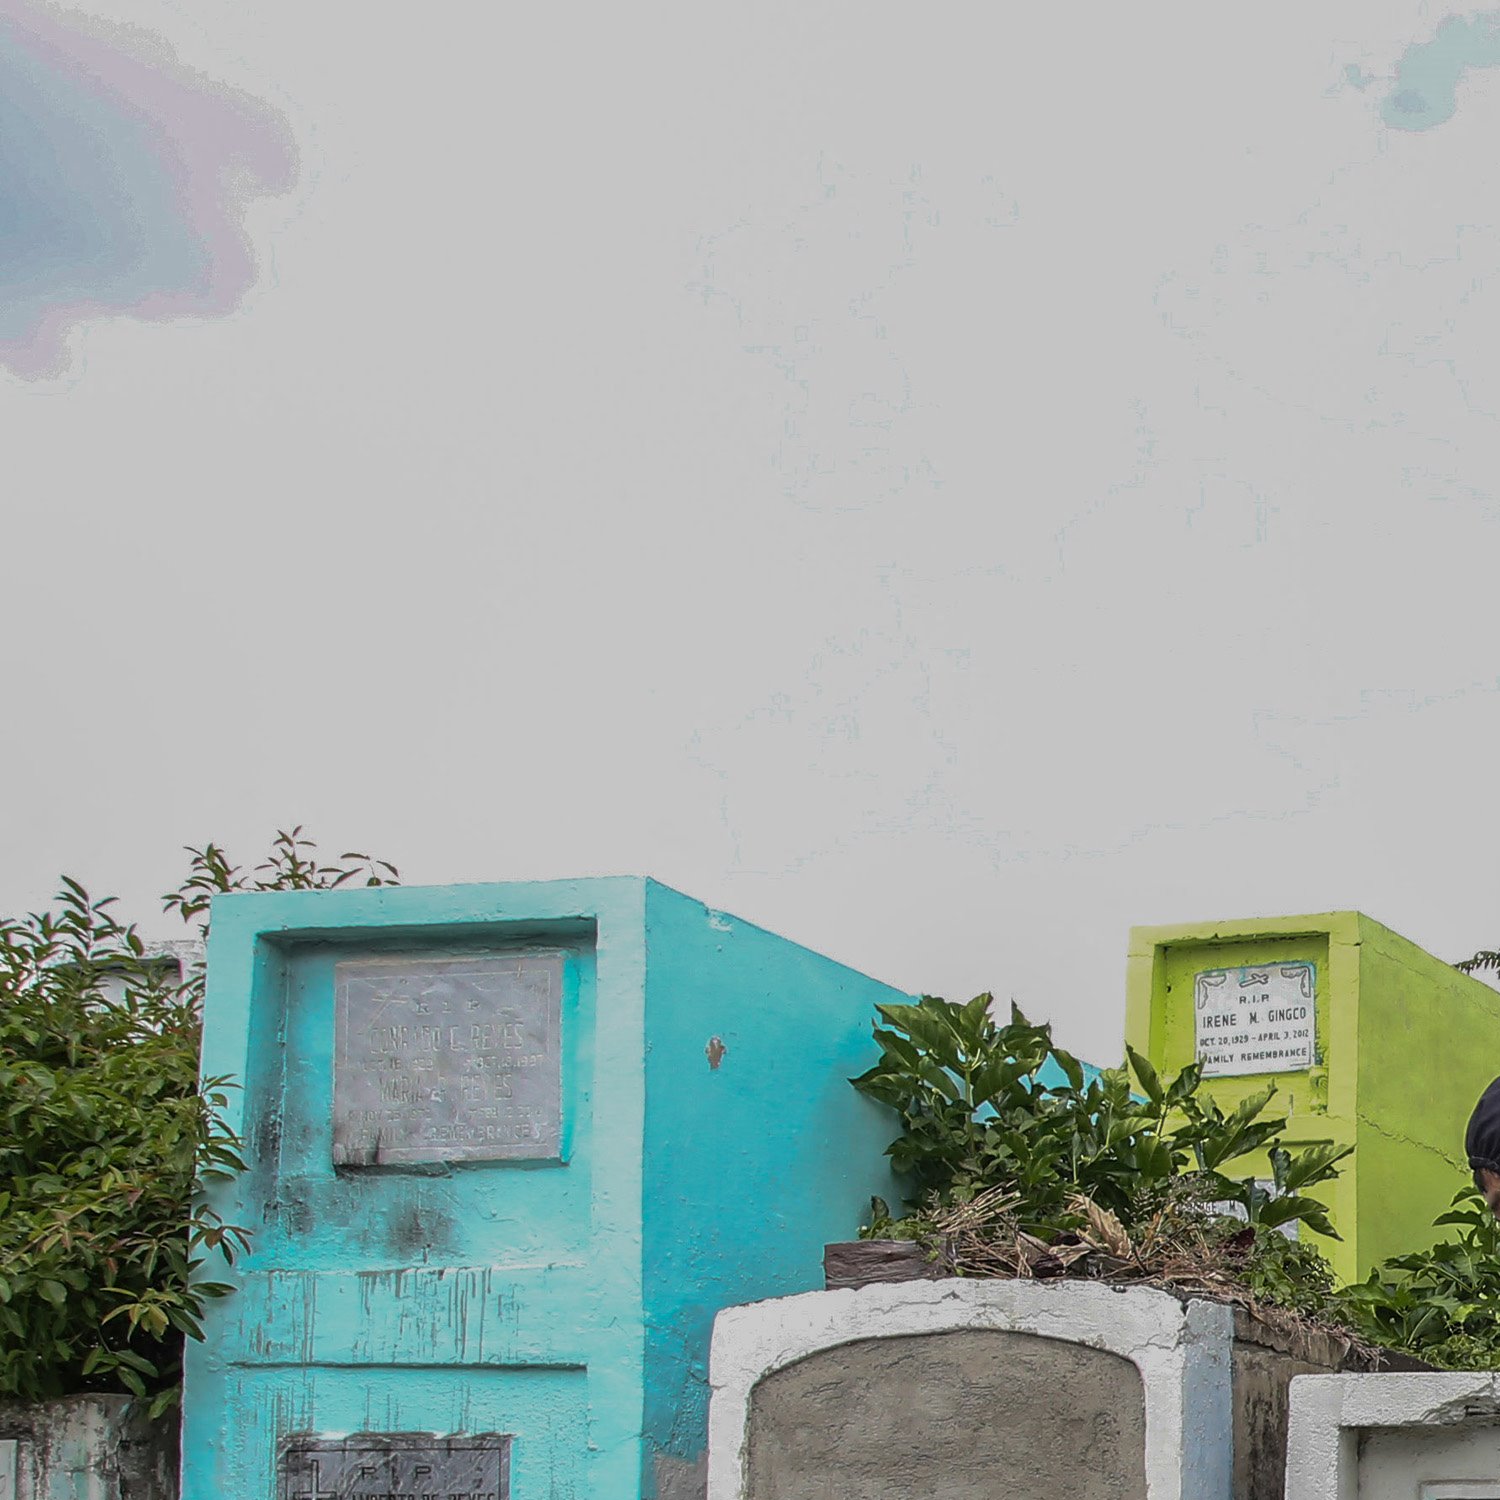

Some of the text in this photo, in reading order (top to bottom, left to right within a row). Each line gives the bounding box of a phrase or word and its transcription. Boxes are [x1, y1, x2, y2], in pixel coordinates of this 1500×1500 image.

[1203, 1013, 1237, 1028] IRENE
[1268, 1007, 1307, 1022] GINGCO
[470, 1023, 525, 1051] REYES
[1258, 1031, 1281, 1042] APRIL
[1293, 1029, 1309, 1039] 2012
[1202, 1047, 1307, 1064] AMILY REMEMBRANCE
